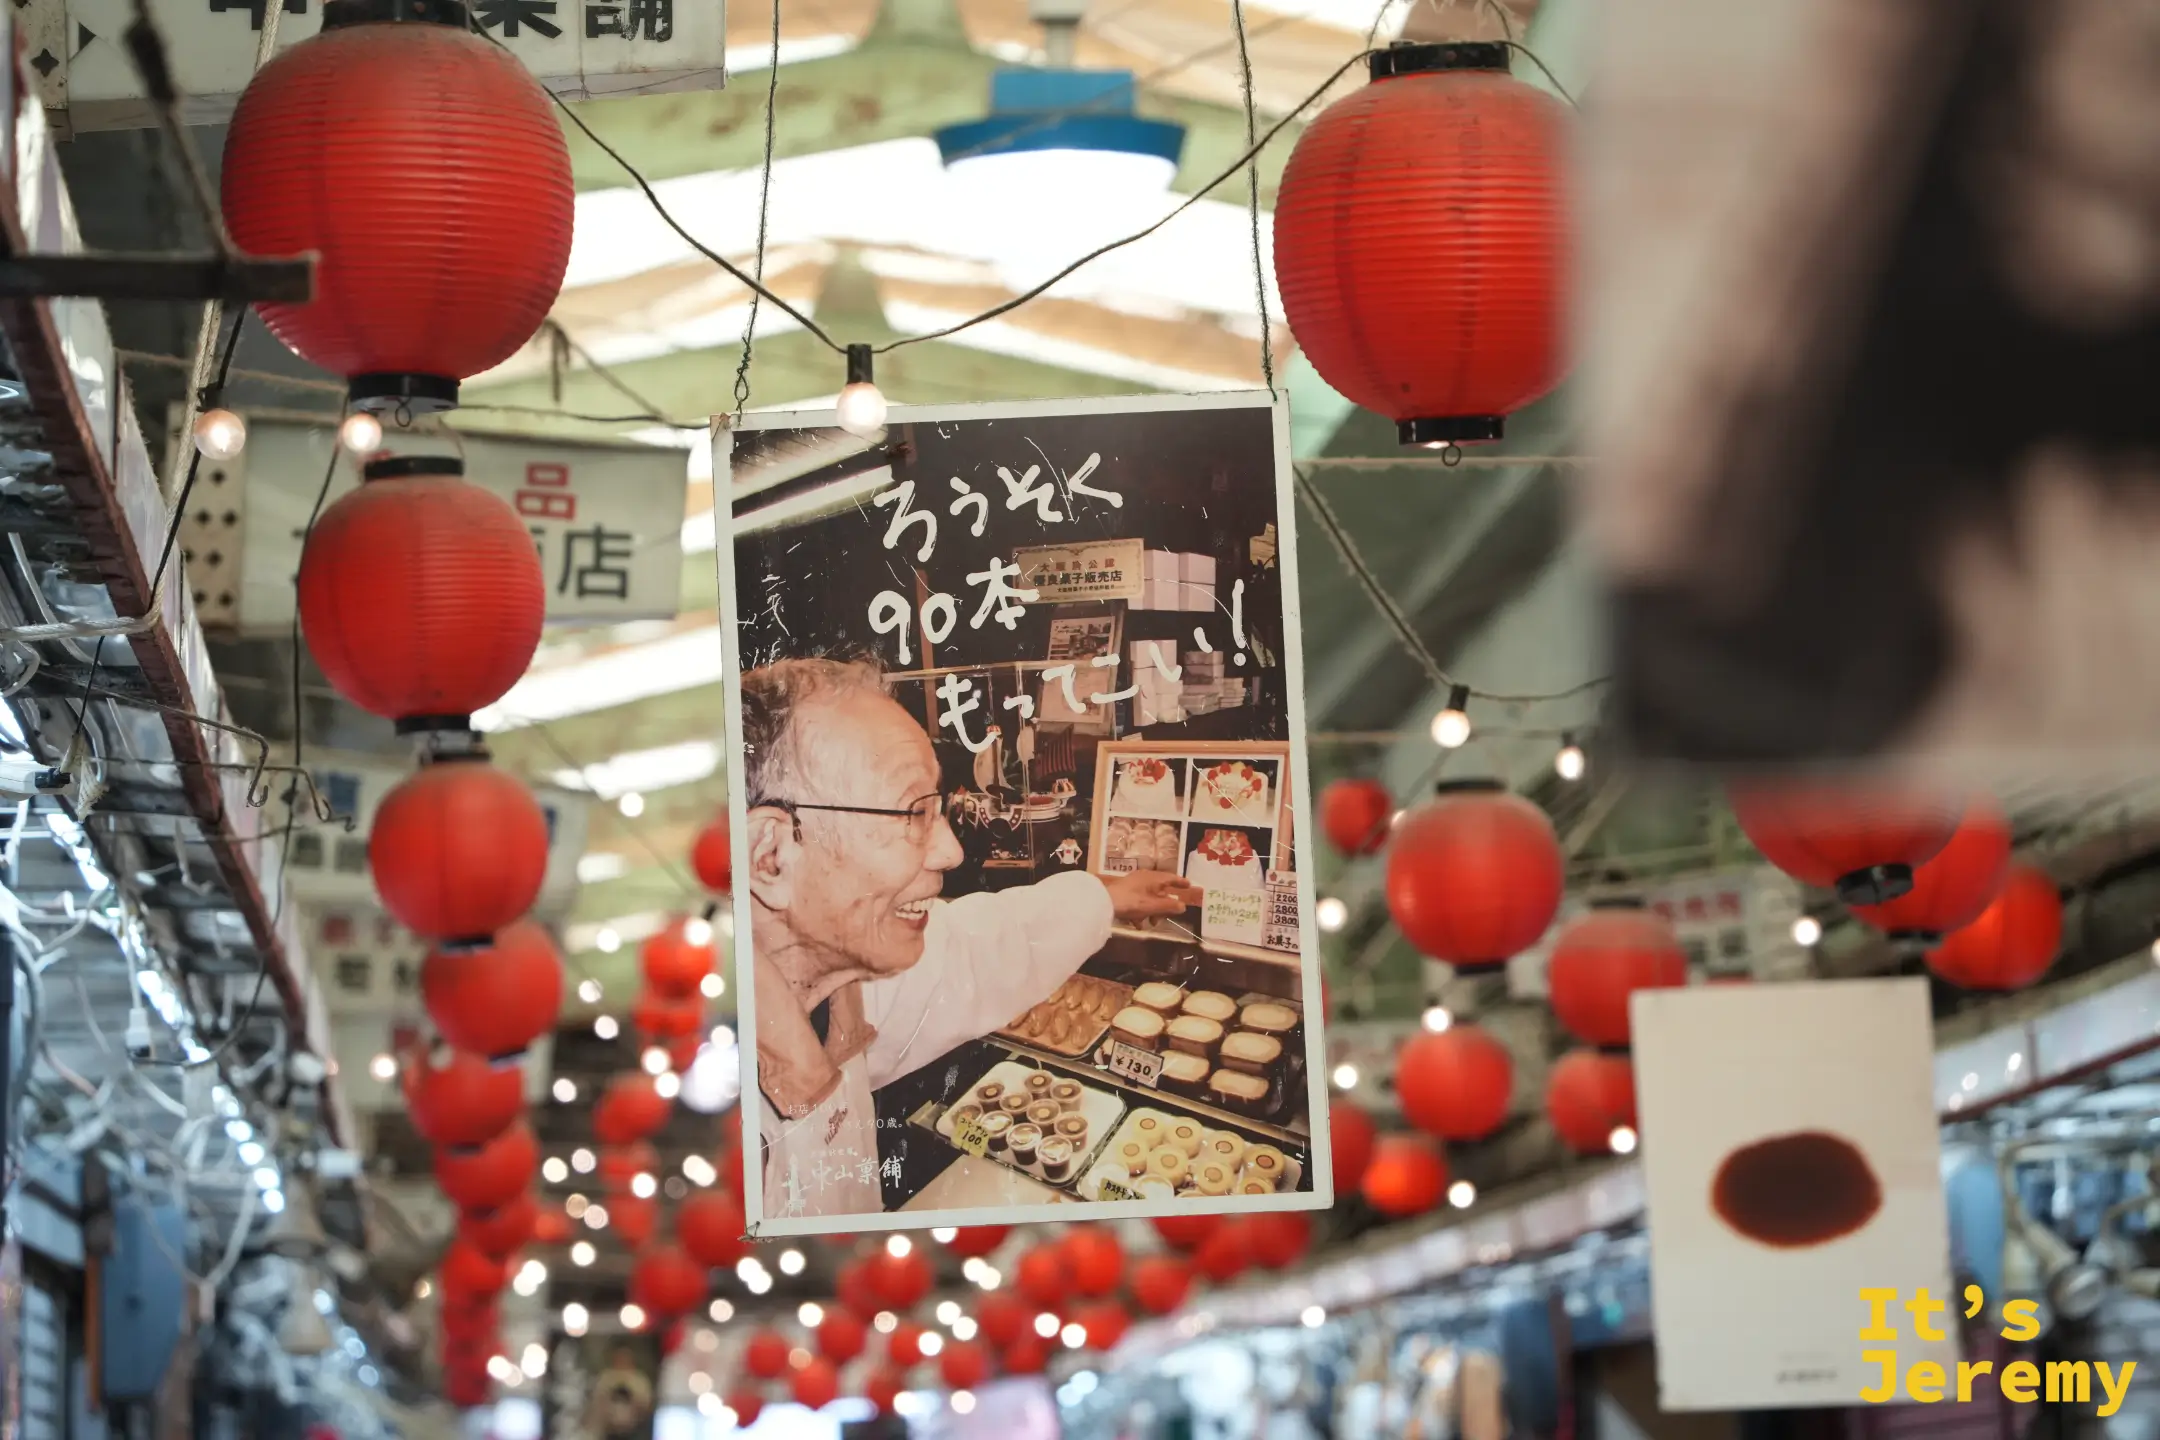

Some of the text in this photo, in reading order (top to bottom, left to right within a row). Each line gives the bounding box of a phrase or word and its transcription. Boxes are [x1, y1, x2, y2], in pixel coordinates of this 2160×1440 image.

[873, 452, 1124, 562] ろうそく
[530, 521, 634, 601] 店
[867, 555, 1041, 666] 90本
[811, 1155, 905, 1196] 中山菓舗
